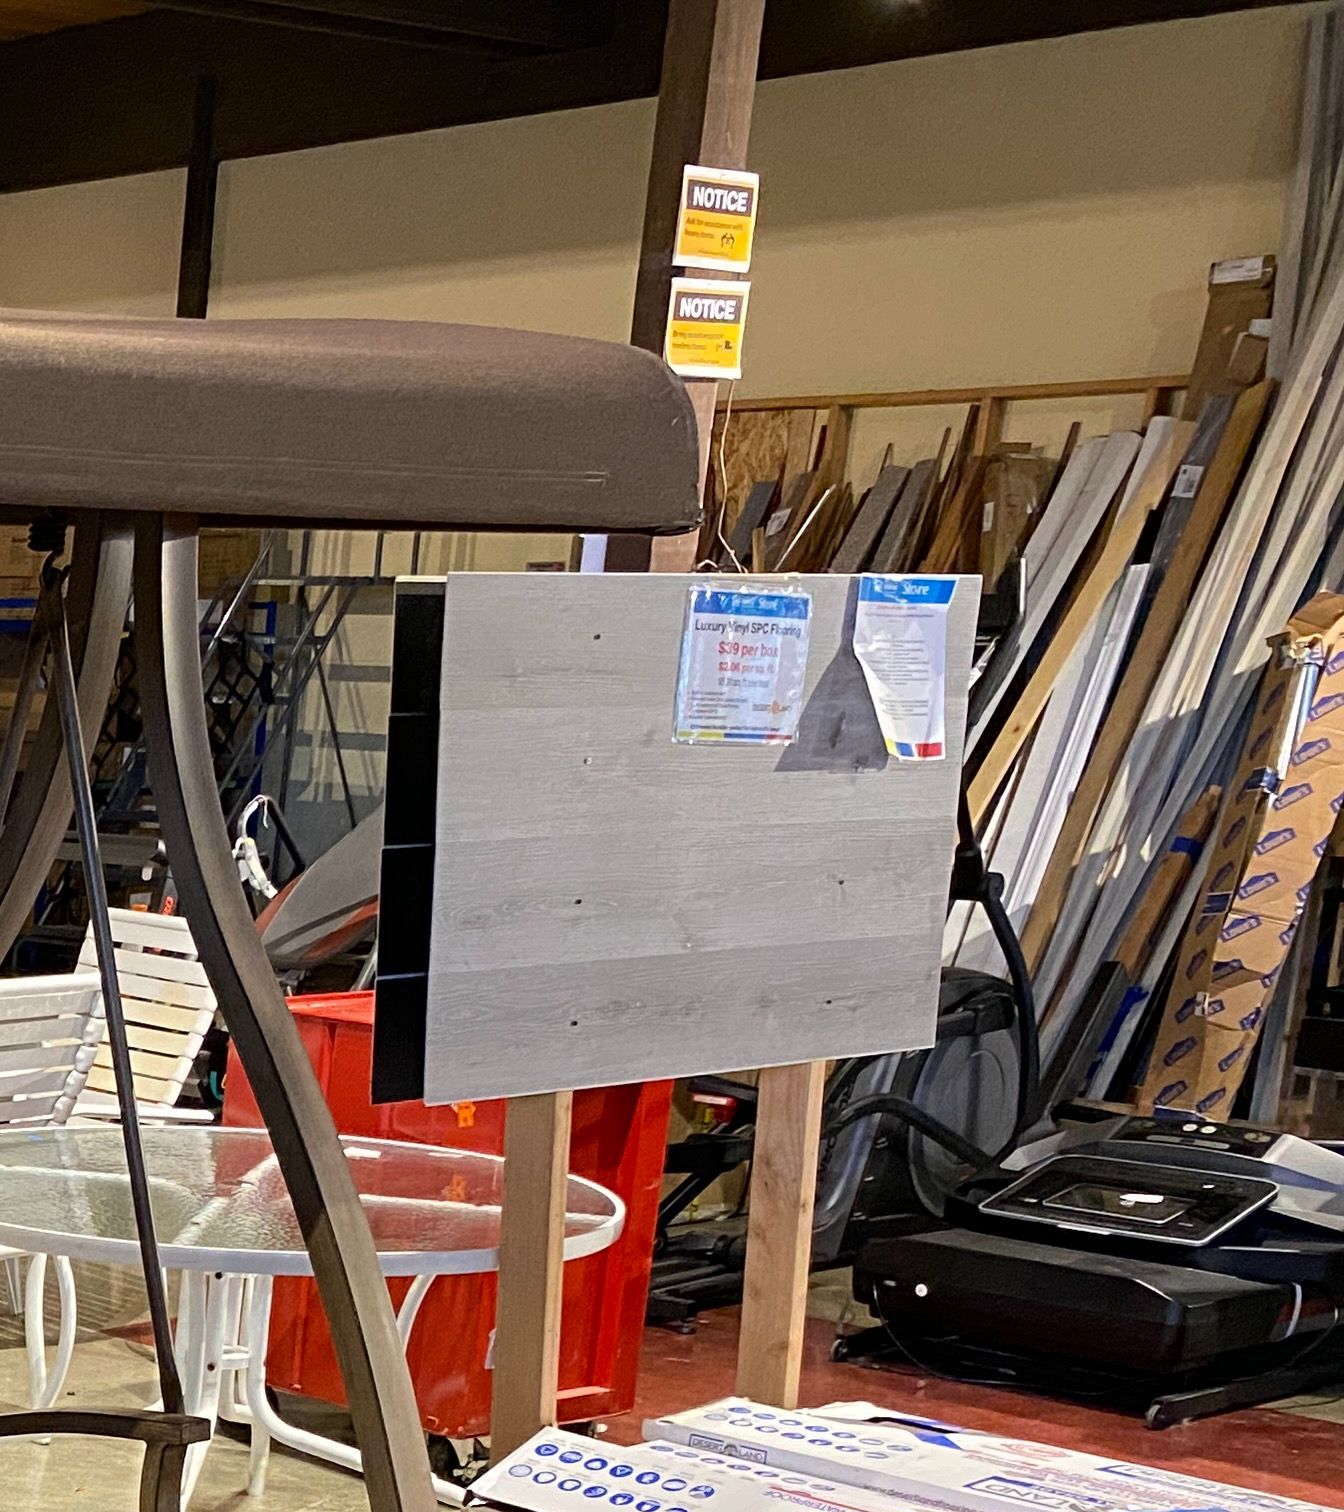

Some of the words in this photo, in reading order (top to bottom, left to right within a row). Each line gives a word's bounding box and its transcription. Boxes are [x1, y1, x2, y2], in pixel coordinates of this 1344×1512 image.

[693, 186, 749, 212] NOTICE
[680, 297, 736, 321] NOTICE
[695, 619, 727, 634] Luxury
[751, 623, 769, 634] SPC
[718, 641, 740, 656] $39
[741, 645, 759, 658] per
[761, 644, 778, 656] box
[737, 1449, 765, 1462] LAND
